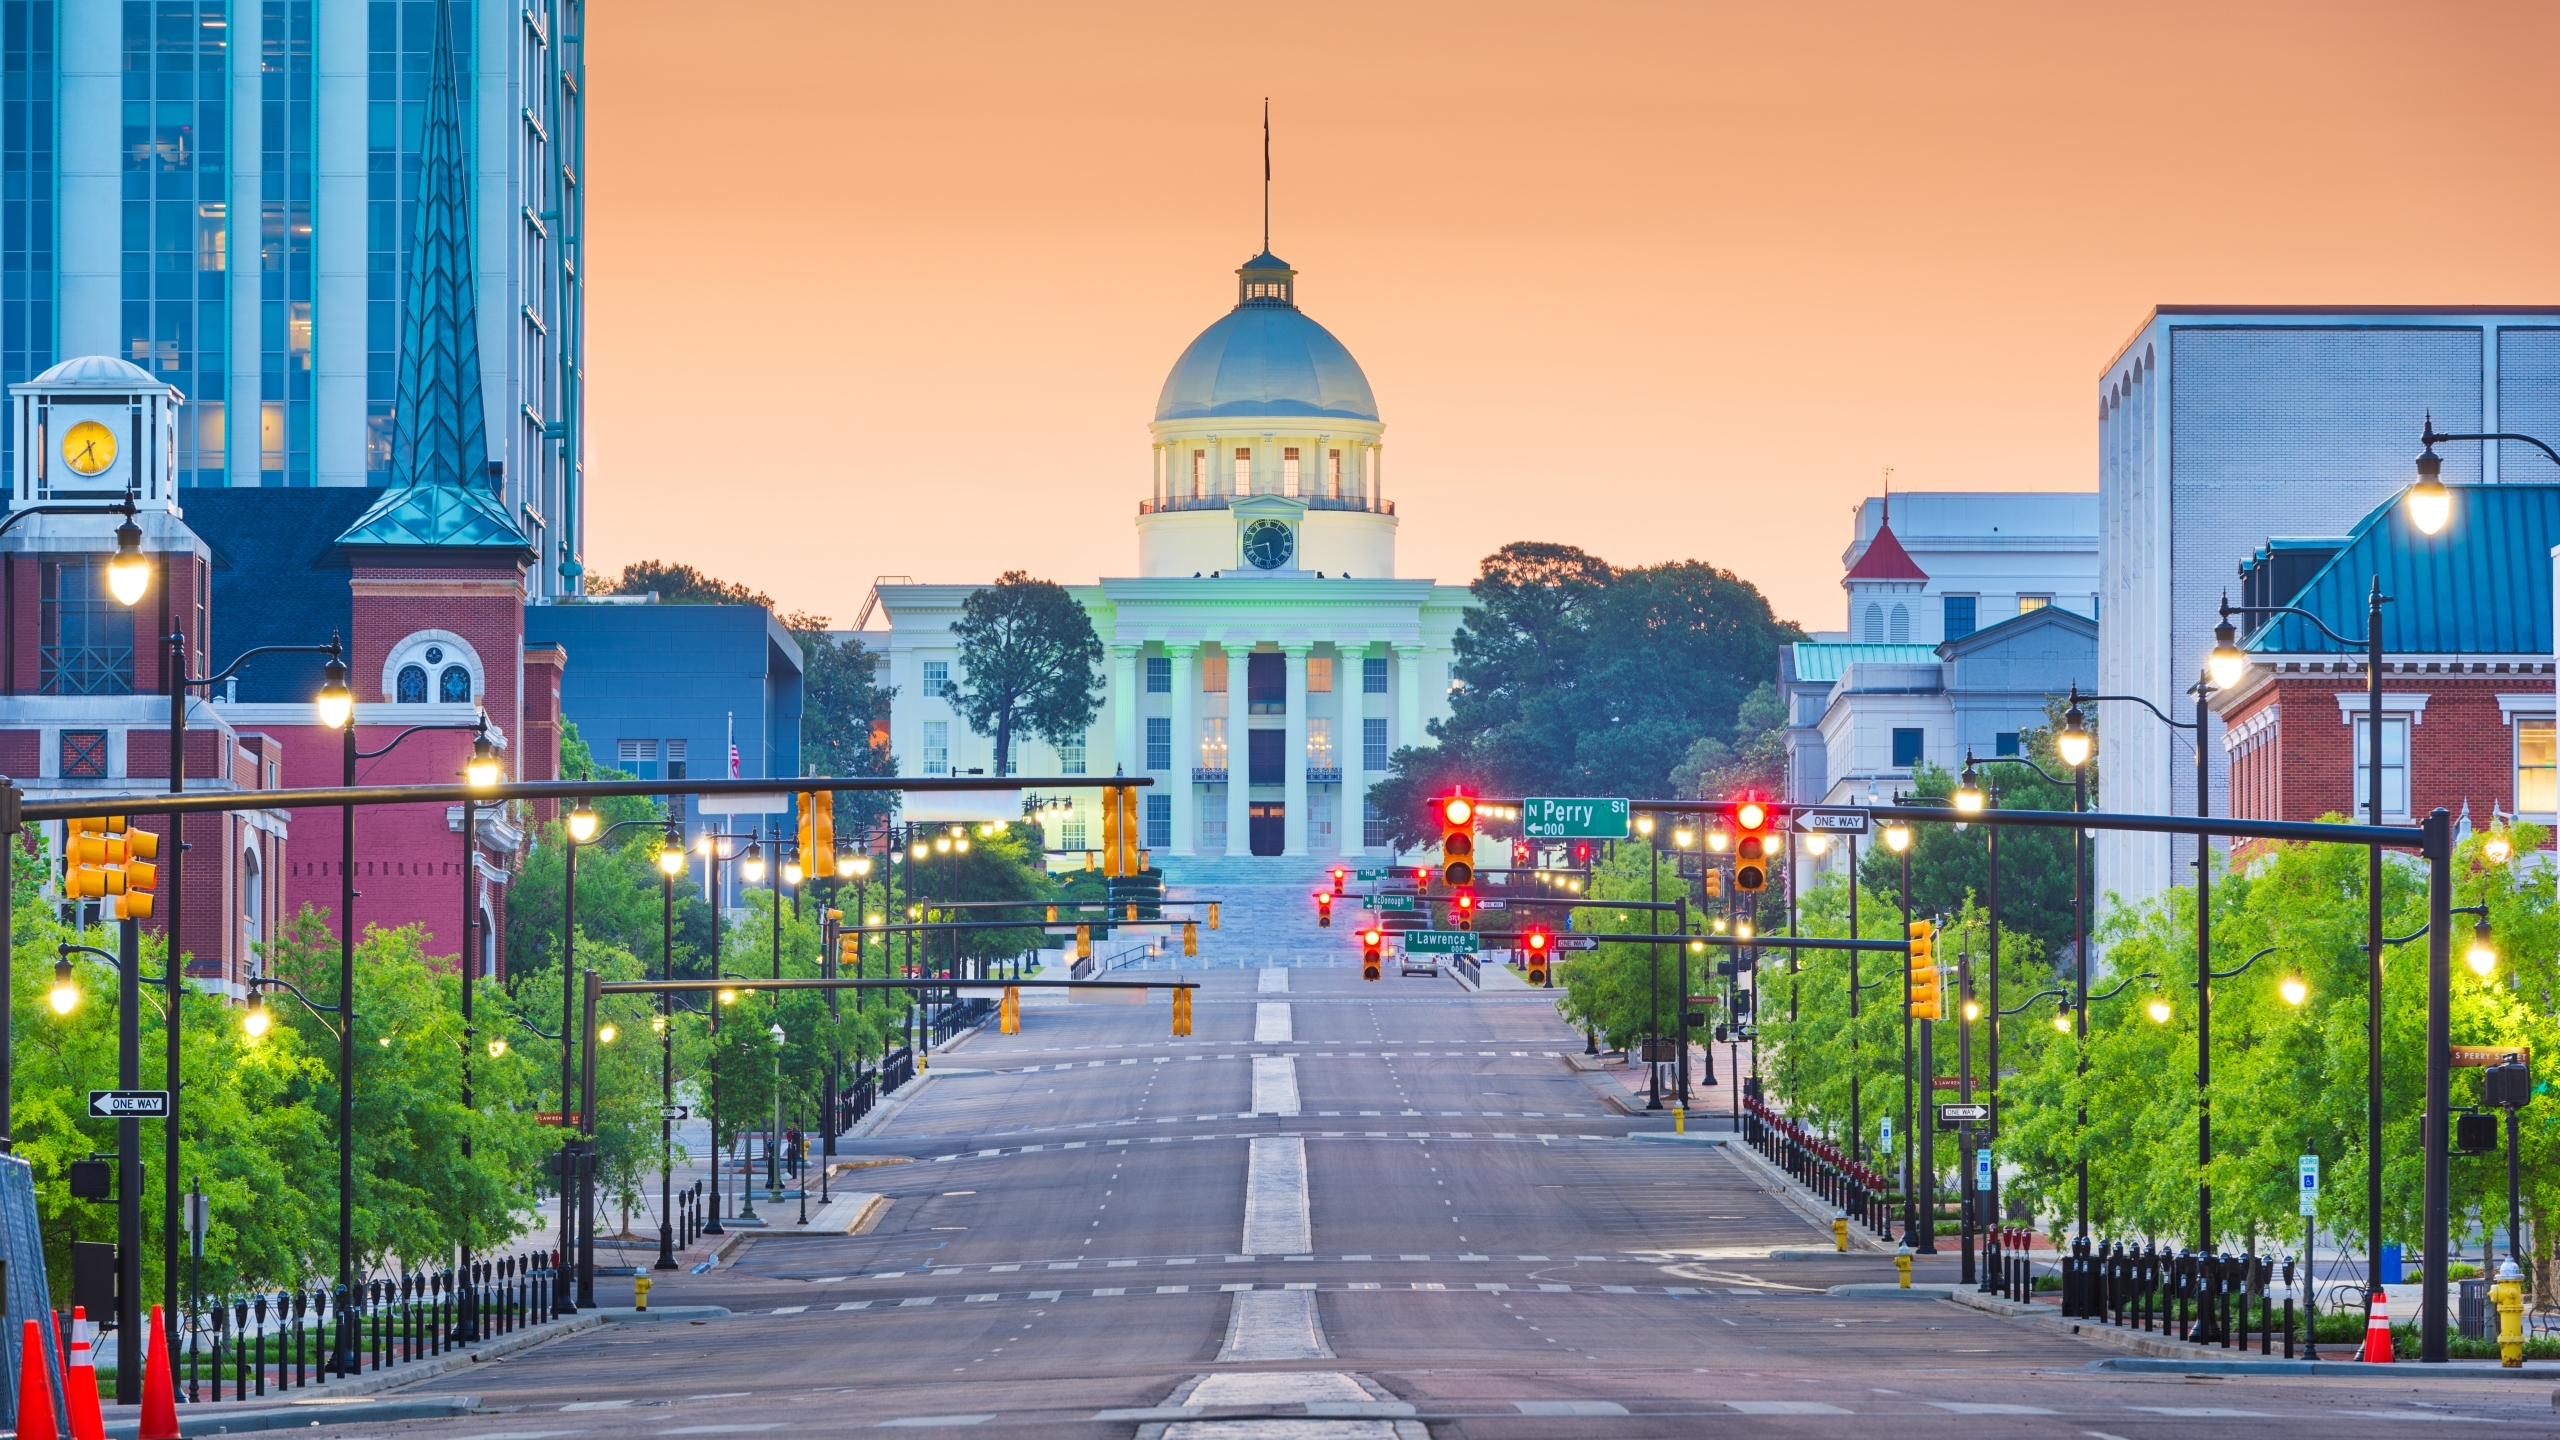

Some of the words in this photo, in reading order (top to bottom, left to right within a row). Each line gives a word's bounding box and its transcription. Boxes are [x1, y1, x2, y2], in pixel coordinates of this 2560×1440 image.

[1528, 804, 1538, 817] N
[1544, 800, 1593, 828] Perry
[1611, 800, 1625, 813] St
[1814, 816, 1836, 827] ONE
[1838, 816, 1861, 827] WAY
[1544, 823, 1565, 836] 000
[1365, 869, 1376, 877] Hull
[1373, 895, 1404, 907] McDonough
[1408, 933, 1413, 941] S
[1417, 931, 1466, 945] Lawrence
[1469, 932, 1476, 941] St
[2455, 1051, 2461, 1060] S
[2464, 1052, 2491, 1060] PERRY
[112, 1098, 134, 1109] ONE
[137, 1098, 159, 1109] WAY
